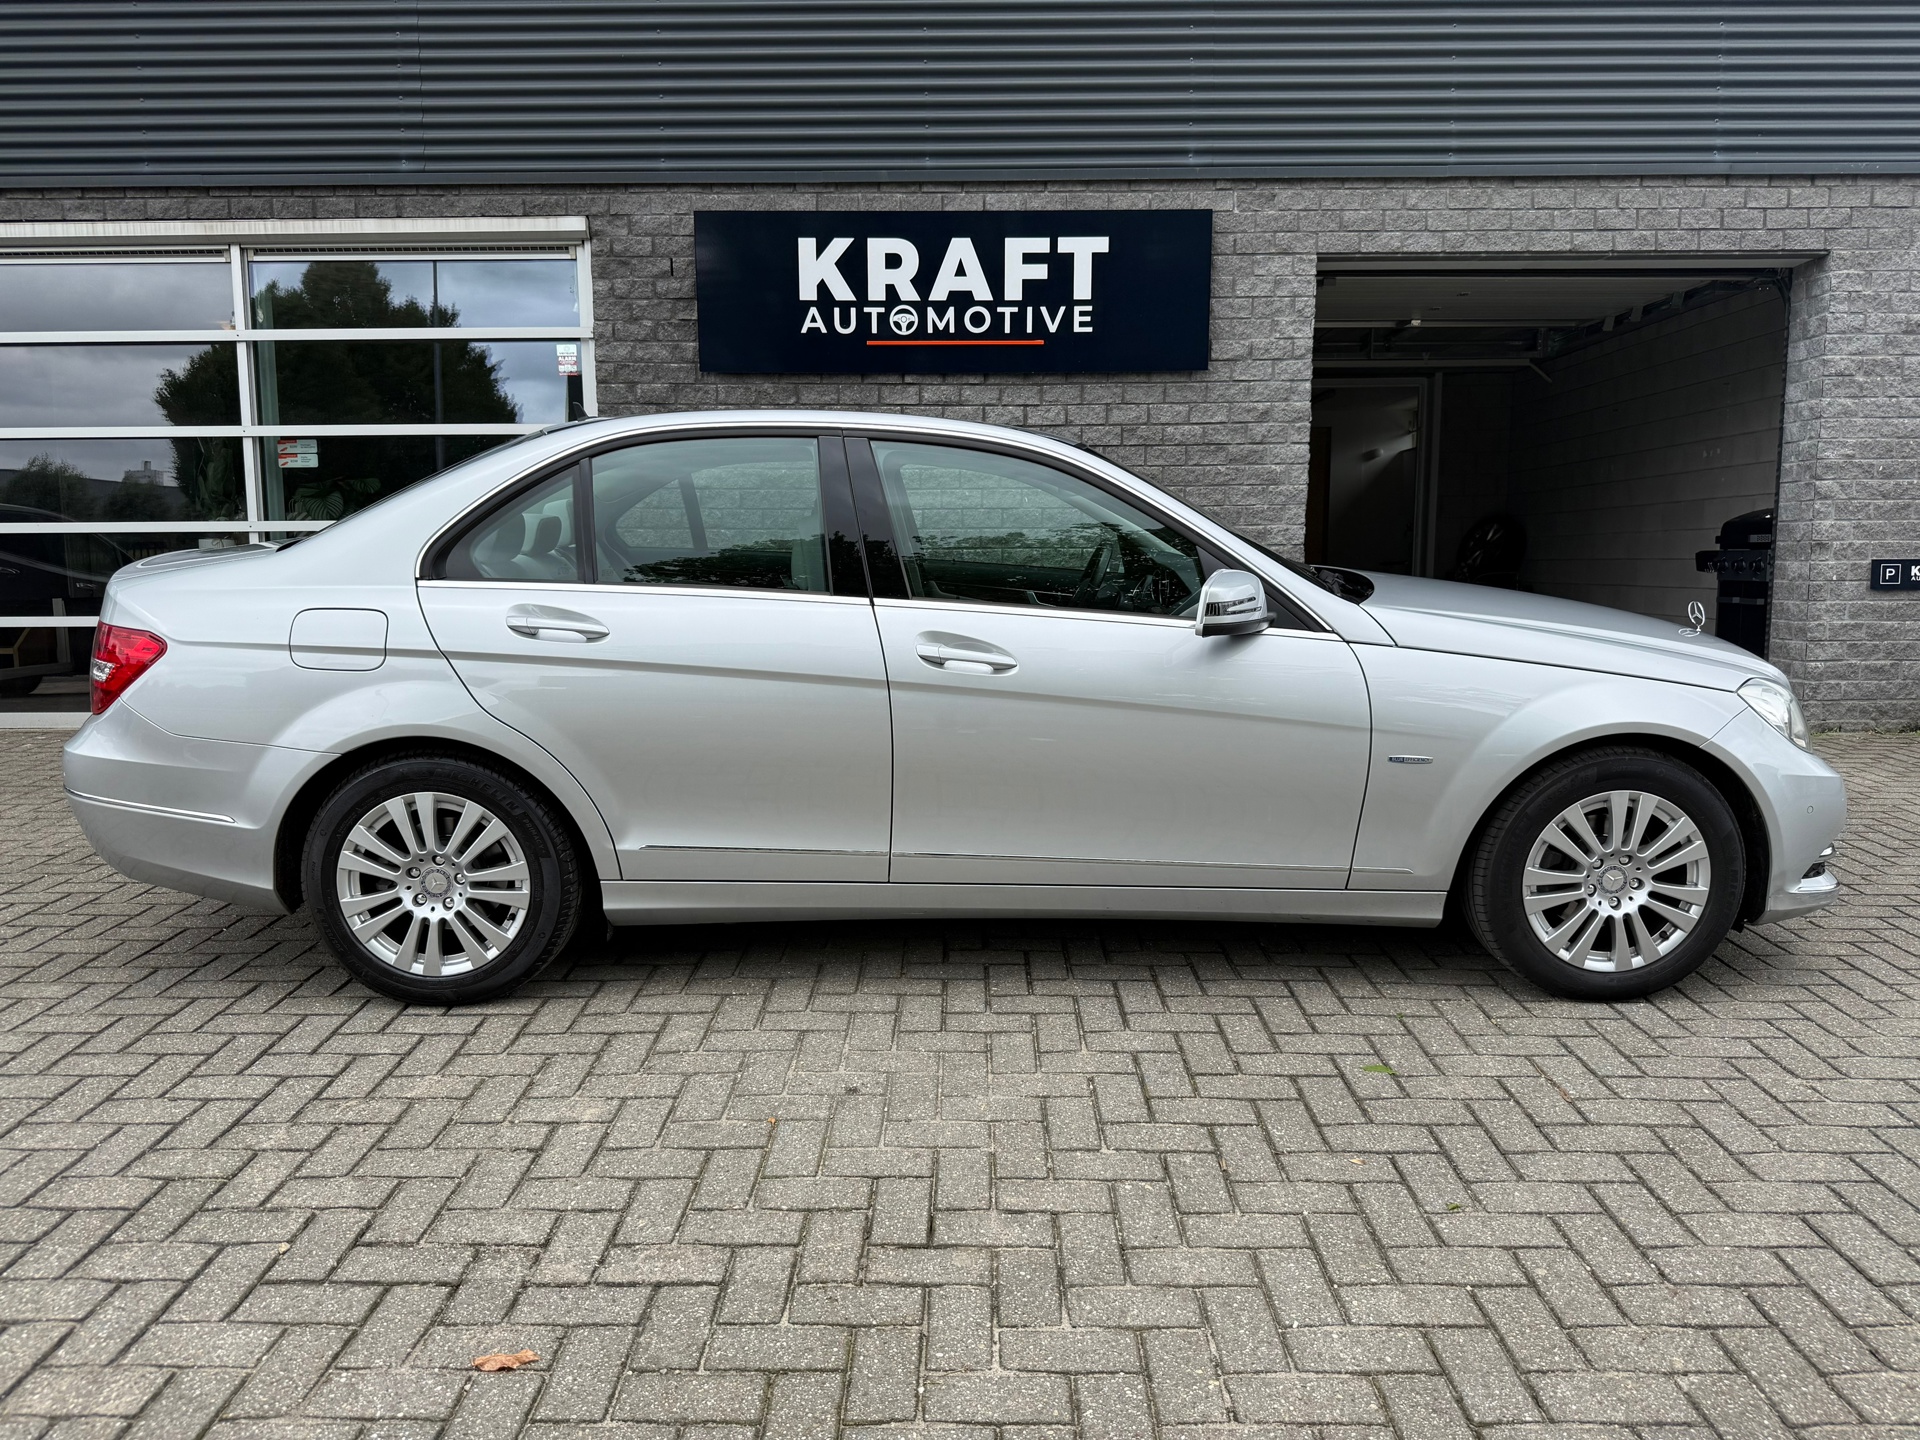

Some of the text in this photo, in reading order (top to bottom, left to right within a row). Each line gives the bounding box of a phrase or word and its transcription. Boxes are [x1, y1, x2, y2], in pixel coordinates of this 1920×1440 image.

[797, 236, 1110, 302] KRAFT
[800, 304, 1094, 336] AUTOMOTIVE
[1885, 568, 1896, 580] P
